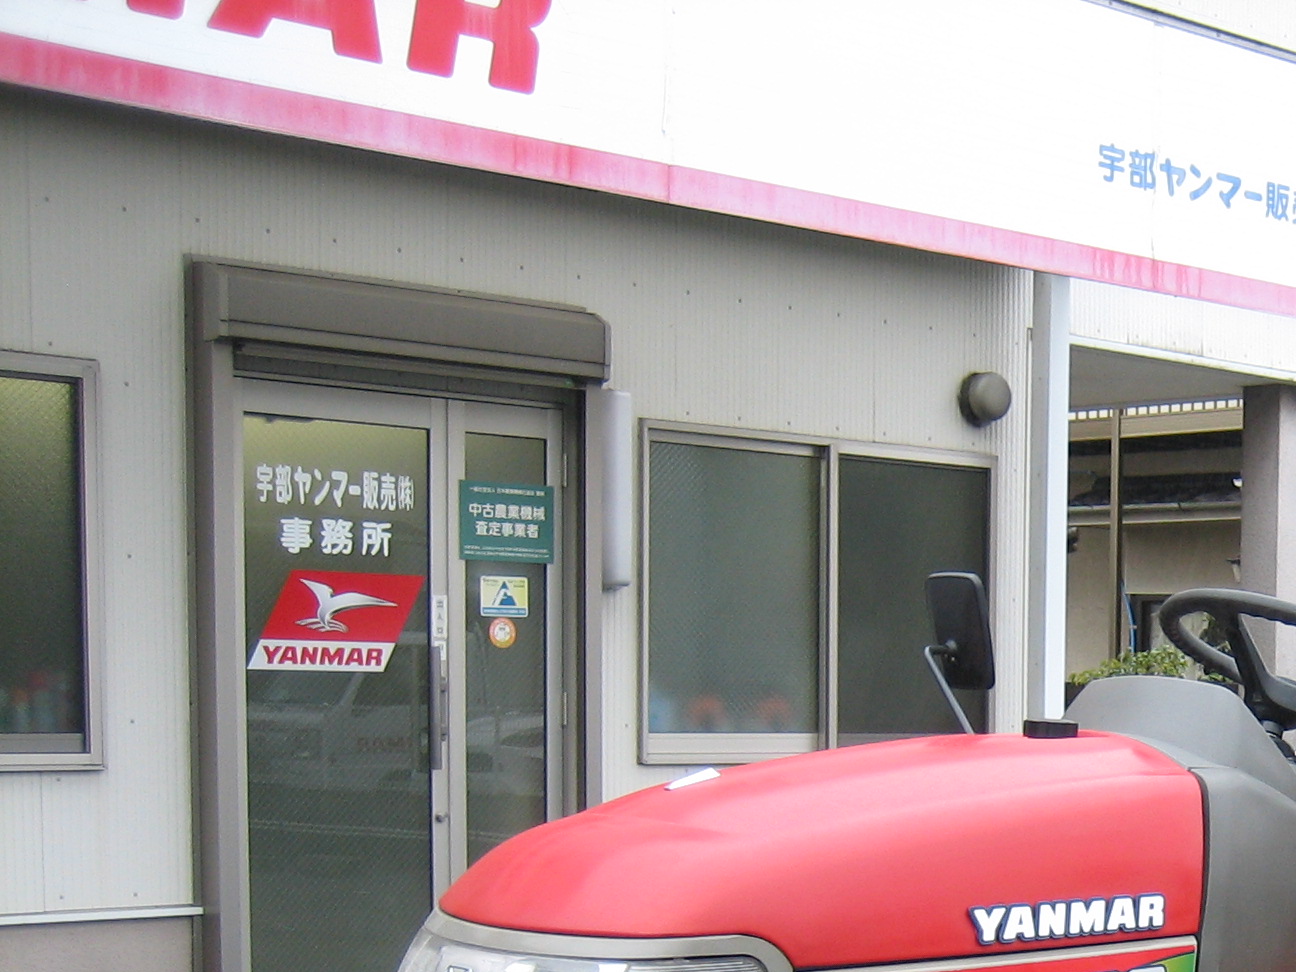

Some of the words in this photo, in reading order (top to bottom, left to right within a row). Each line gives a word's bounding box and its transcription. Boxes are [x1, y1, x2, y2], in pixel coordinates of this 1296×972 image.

[468, 503, 546, 521] 中古農業機械
[279, 516, 394, 557] 事務所
[474, 521, 539, 539] 査定事業者
[262, 644, 385, 667] YANMAR
[968, 893, 1166, 945] YANMAR
